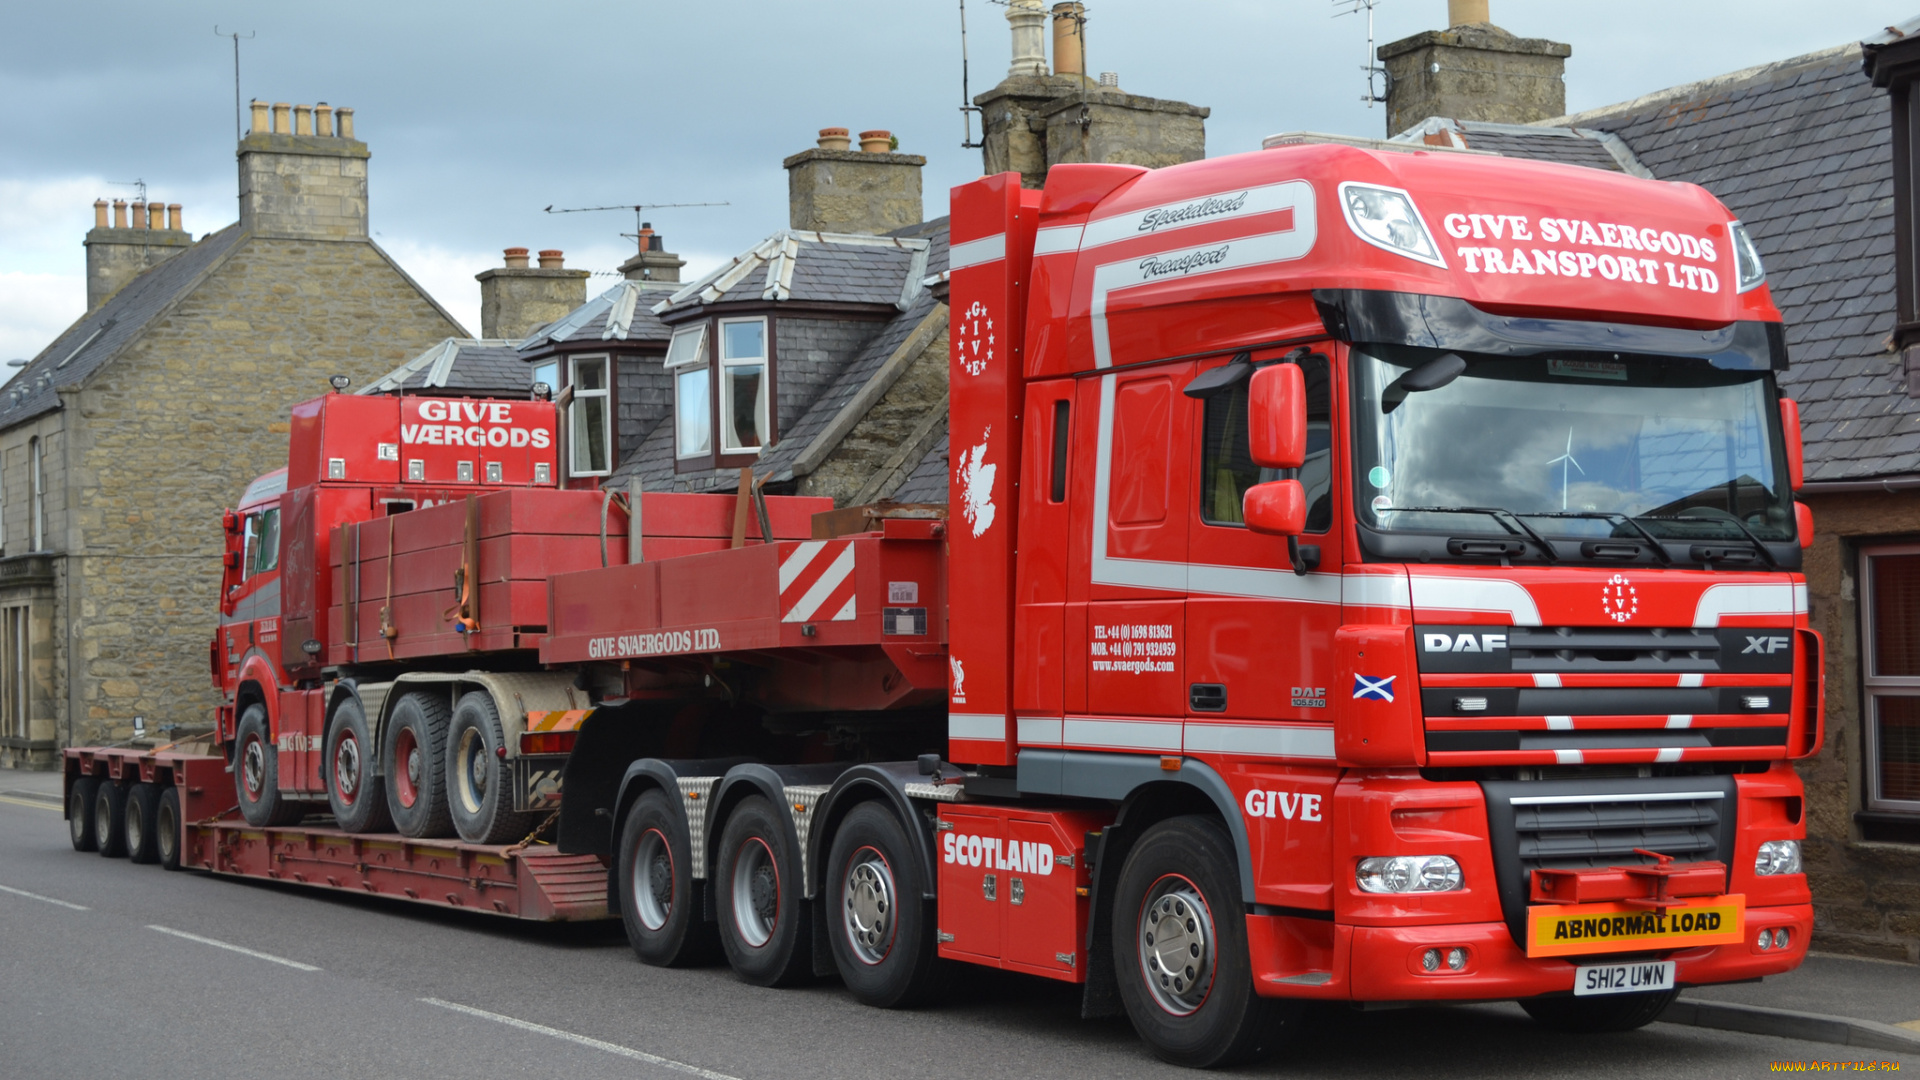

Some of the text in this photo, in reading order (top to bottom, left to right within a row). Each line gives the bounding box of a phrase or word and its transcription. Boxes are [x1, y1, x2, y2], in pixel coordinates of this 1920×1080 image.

[1138, 191, 1248, 232] Specialised
[1444, 213, 1718, 262] GIVE SVAERGODS
[1139, 244, 1230, 279] Transport
[1457, 246, 1720, 293] TRANSPORT LTD
[418, 400, 513, 424] GIVE
[588, 628, 721, 658] GIVE SVAERGODS LTD.
[1120, 623, 1130, 641] (0)
[1131, 625, 1147, 639] 1698
[1148, 624, 1173, 639] 813621
[1423, 633, 1507, 653] DAF
[1741, 636, 1789, 654] XF
[1091, 641, 1176, 658] MOB. +44 (0) 791 9324959
[1092, 656, 1175, 675] www.svaergods.com
[1291, 686, 1326, 698] DAF
[1244, 788, 1322, 822] GIVE
[943, 832, 1054, 876] SCOTLAND
[1554, 912, 1721, 940] ABNORMAL LOAD
[1585, 964, 1665, 990] SH12 UWN
